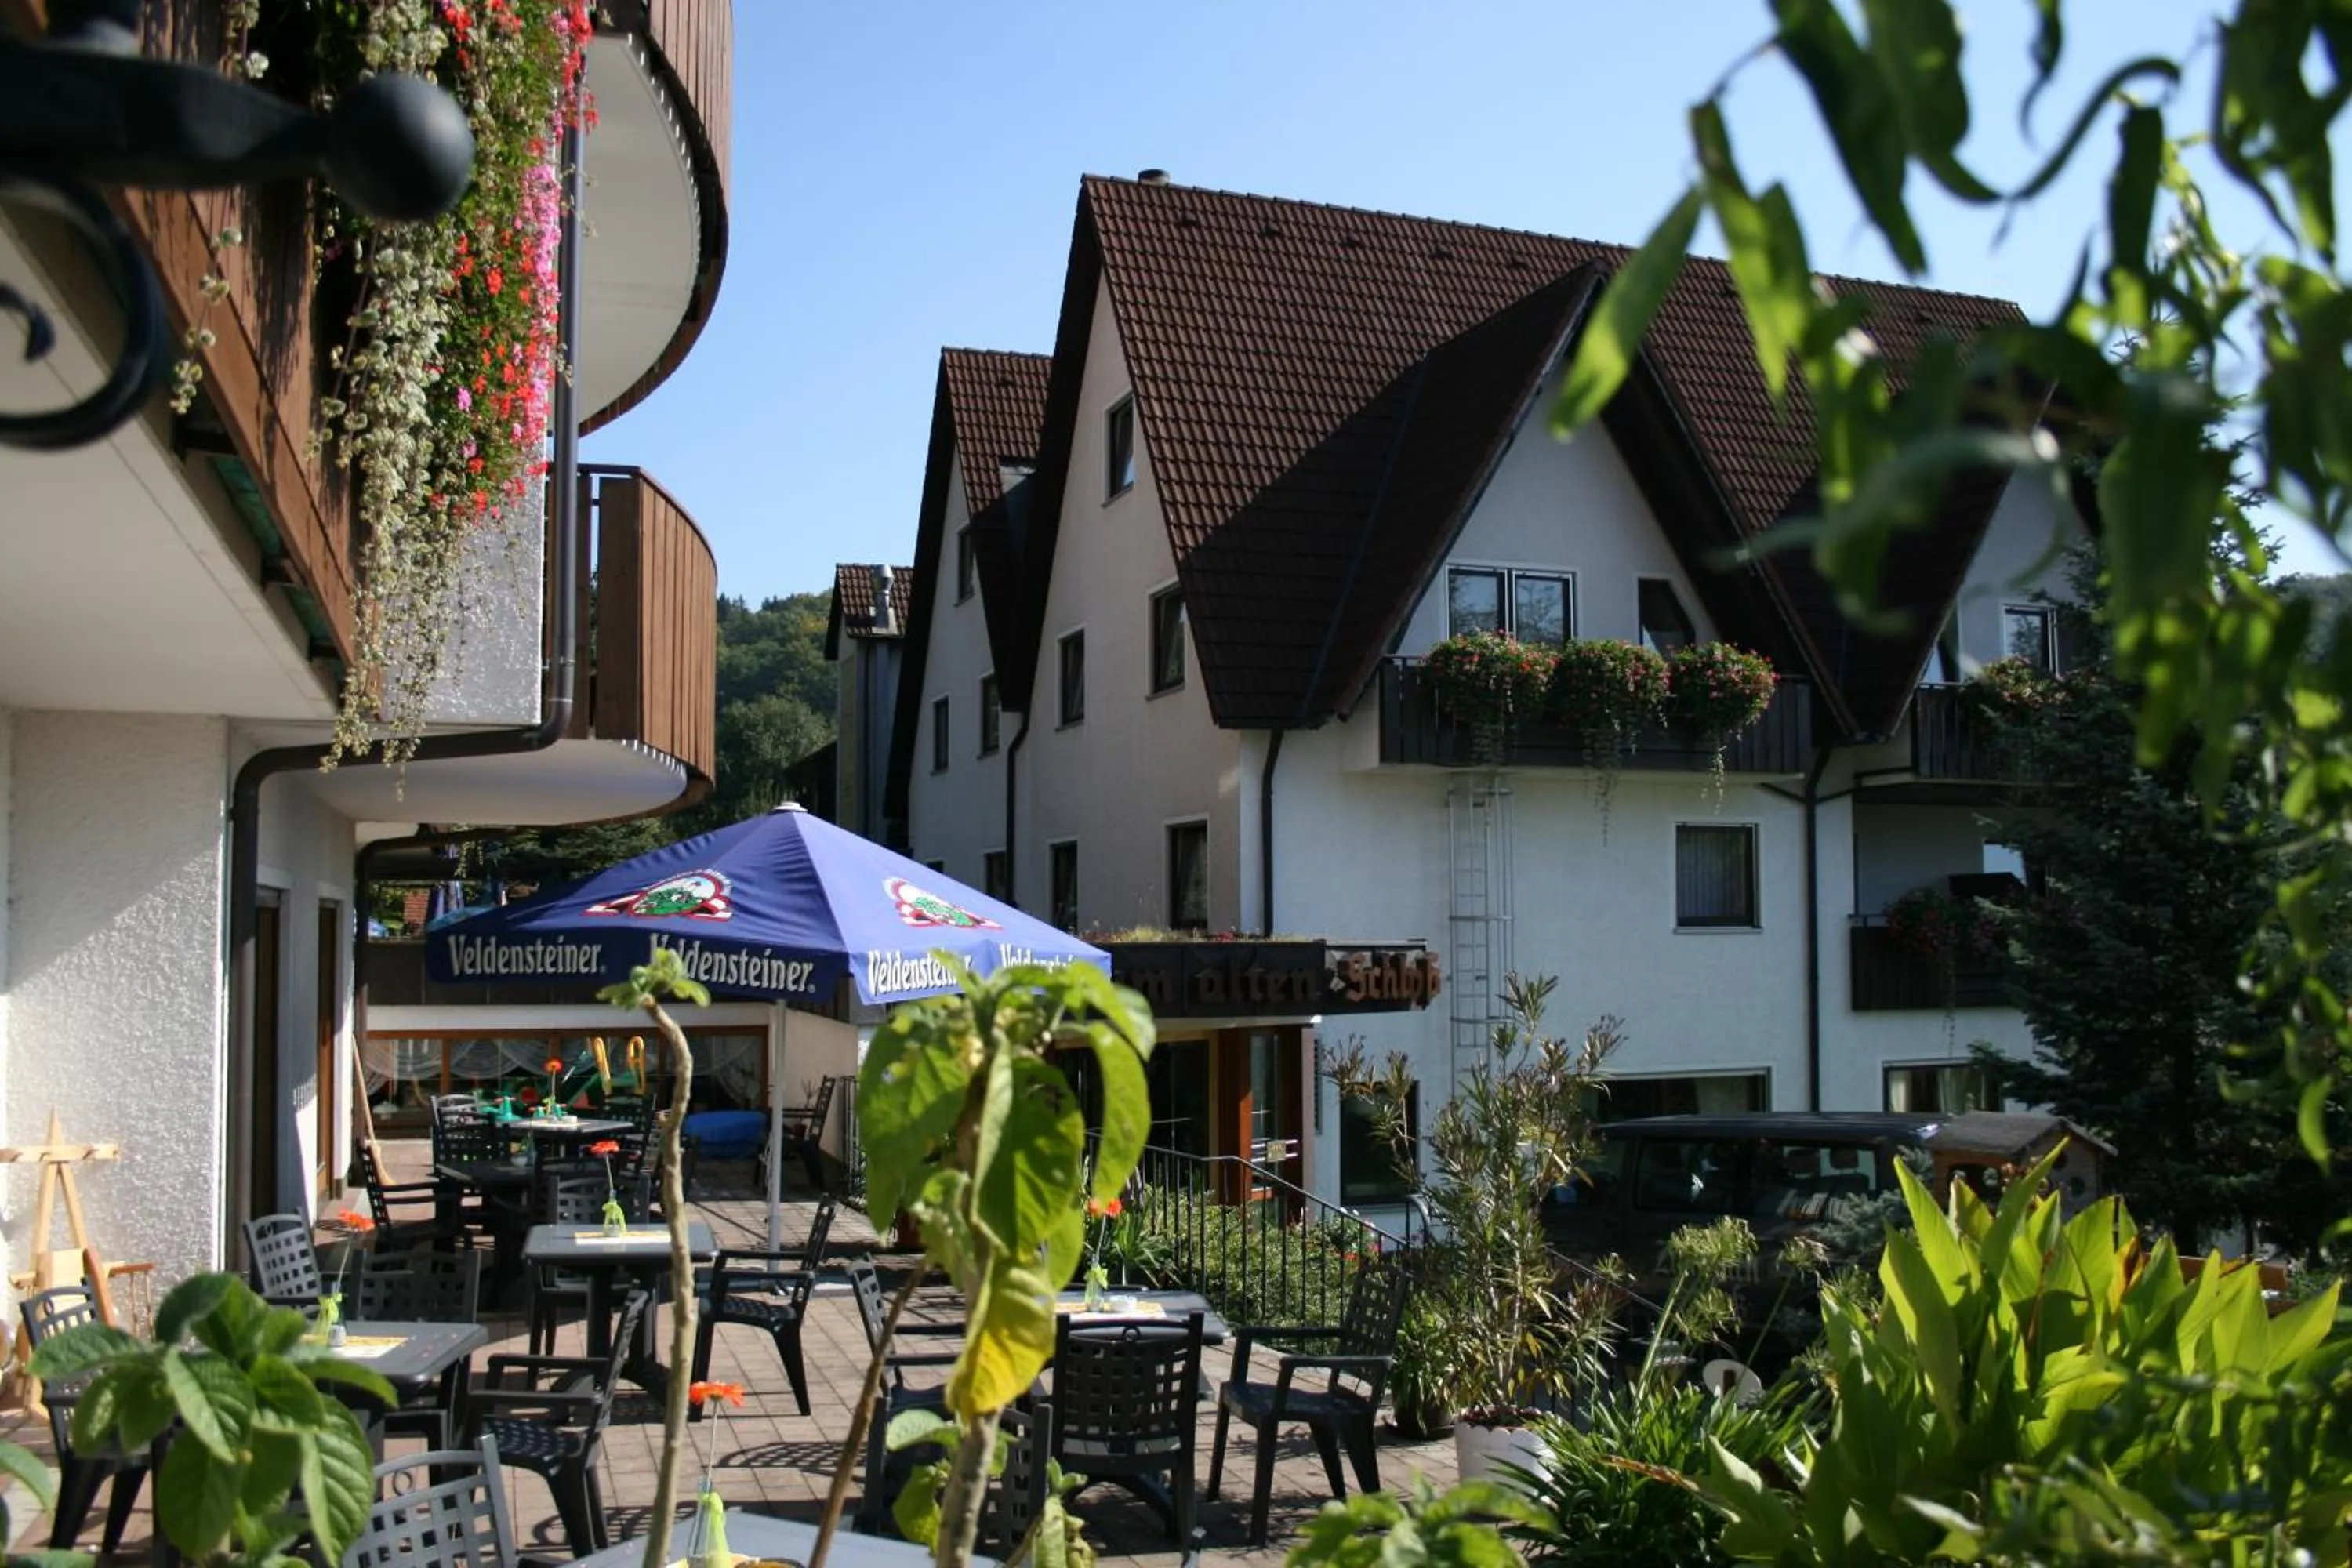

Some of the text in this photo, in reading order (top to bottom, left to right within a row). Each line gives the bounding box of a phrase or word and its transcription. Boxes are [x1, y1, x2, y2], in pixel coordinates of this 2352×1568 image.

[448, 934, 602, 978] Veldensteiner
[650, 933, 815, 993] Vldensteiner
[1196, 953, 1323, 1004] alten
